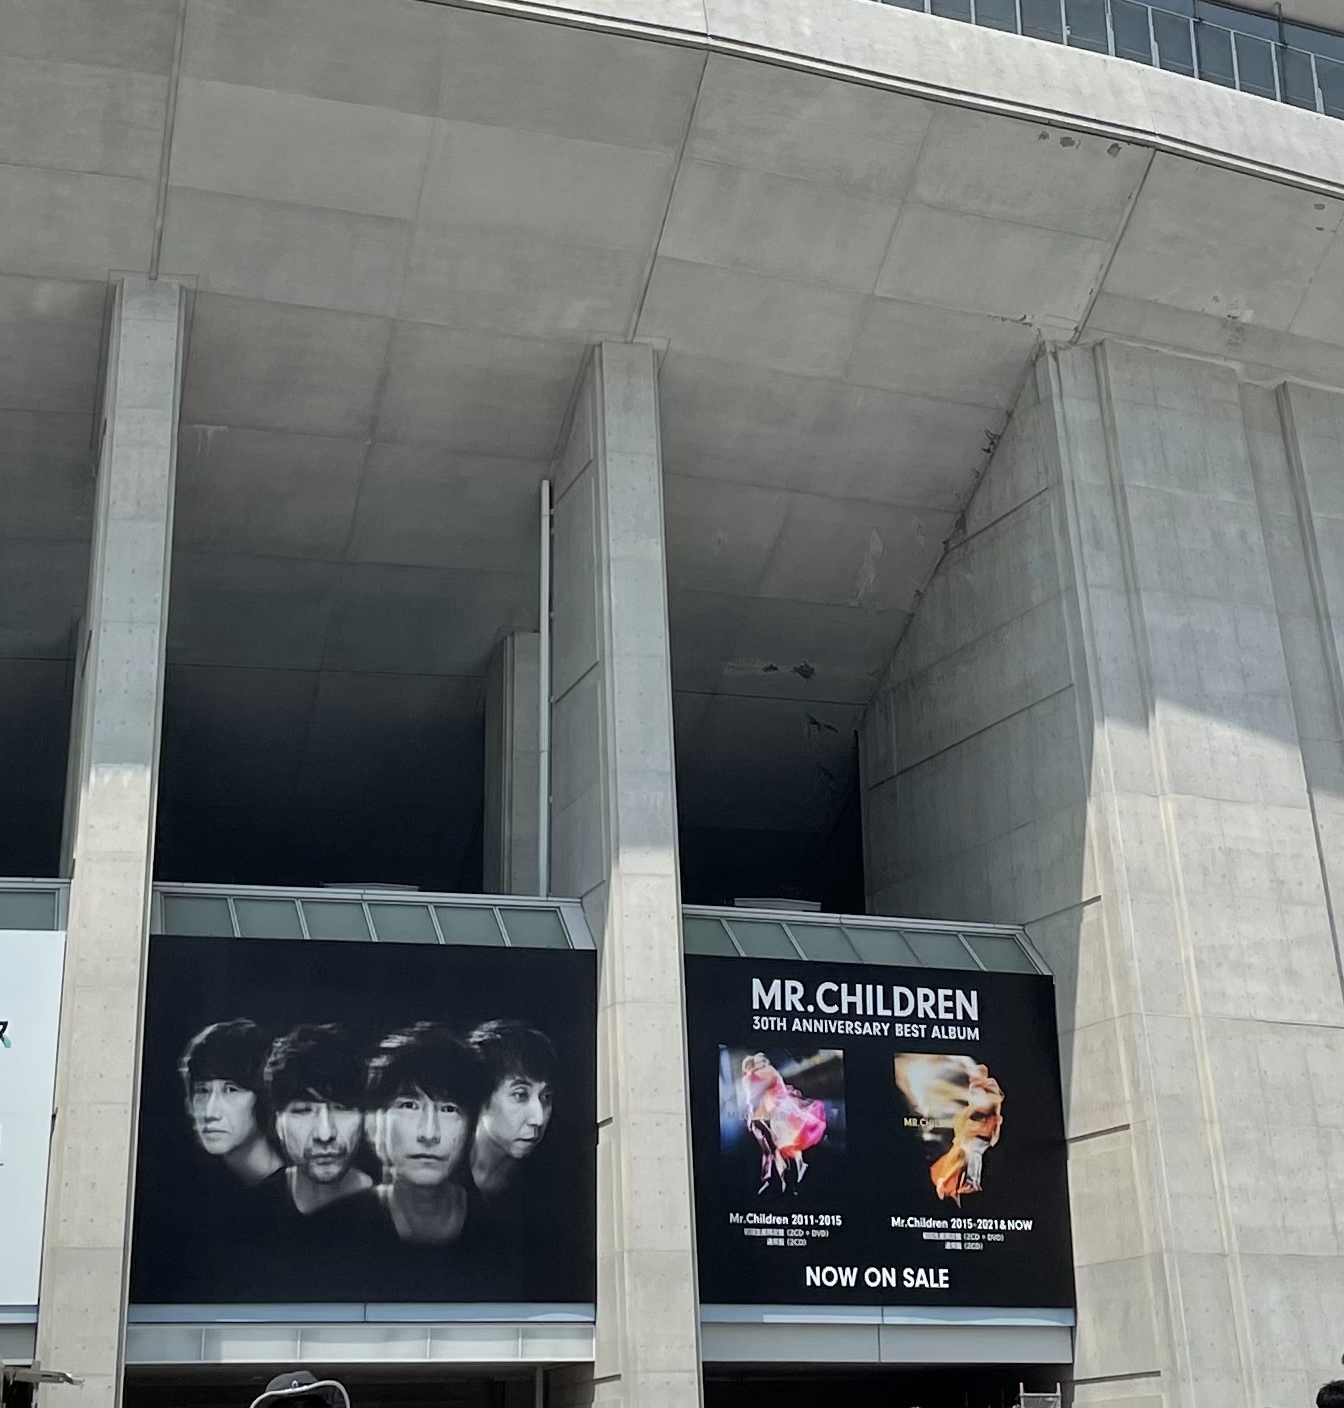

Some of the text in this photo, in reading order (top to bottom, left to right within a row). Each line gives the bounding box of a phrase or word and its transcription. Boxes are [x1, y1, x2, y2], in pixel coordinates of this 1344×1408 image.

[752, 978, 979, 1021] MR.CHILDREN
[752, 1016, 980, 1041] 30TH ANNIVERSARY BEST ALBUM
[729, 1213, 843, 1226] Mr.Children 2011-2015
[891, 1216, 948, 1229] Mr.Children
[805, 1265, 950, 1289] NOW ON SALE
